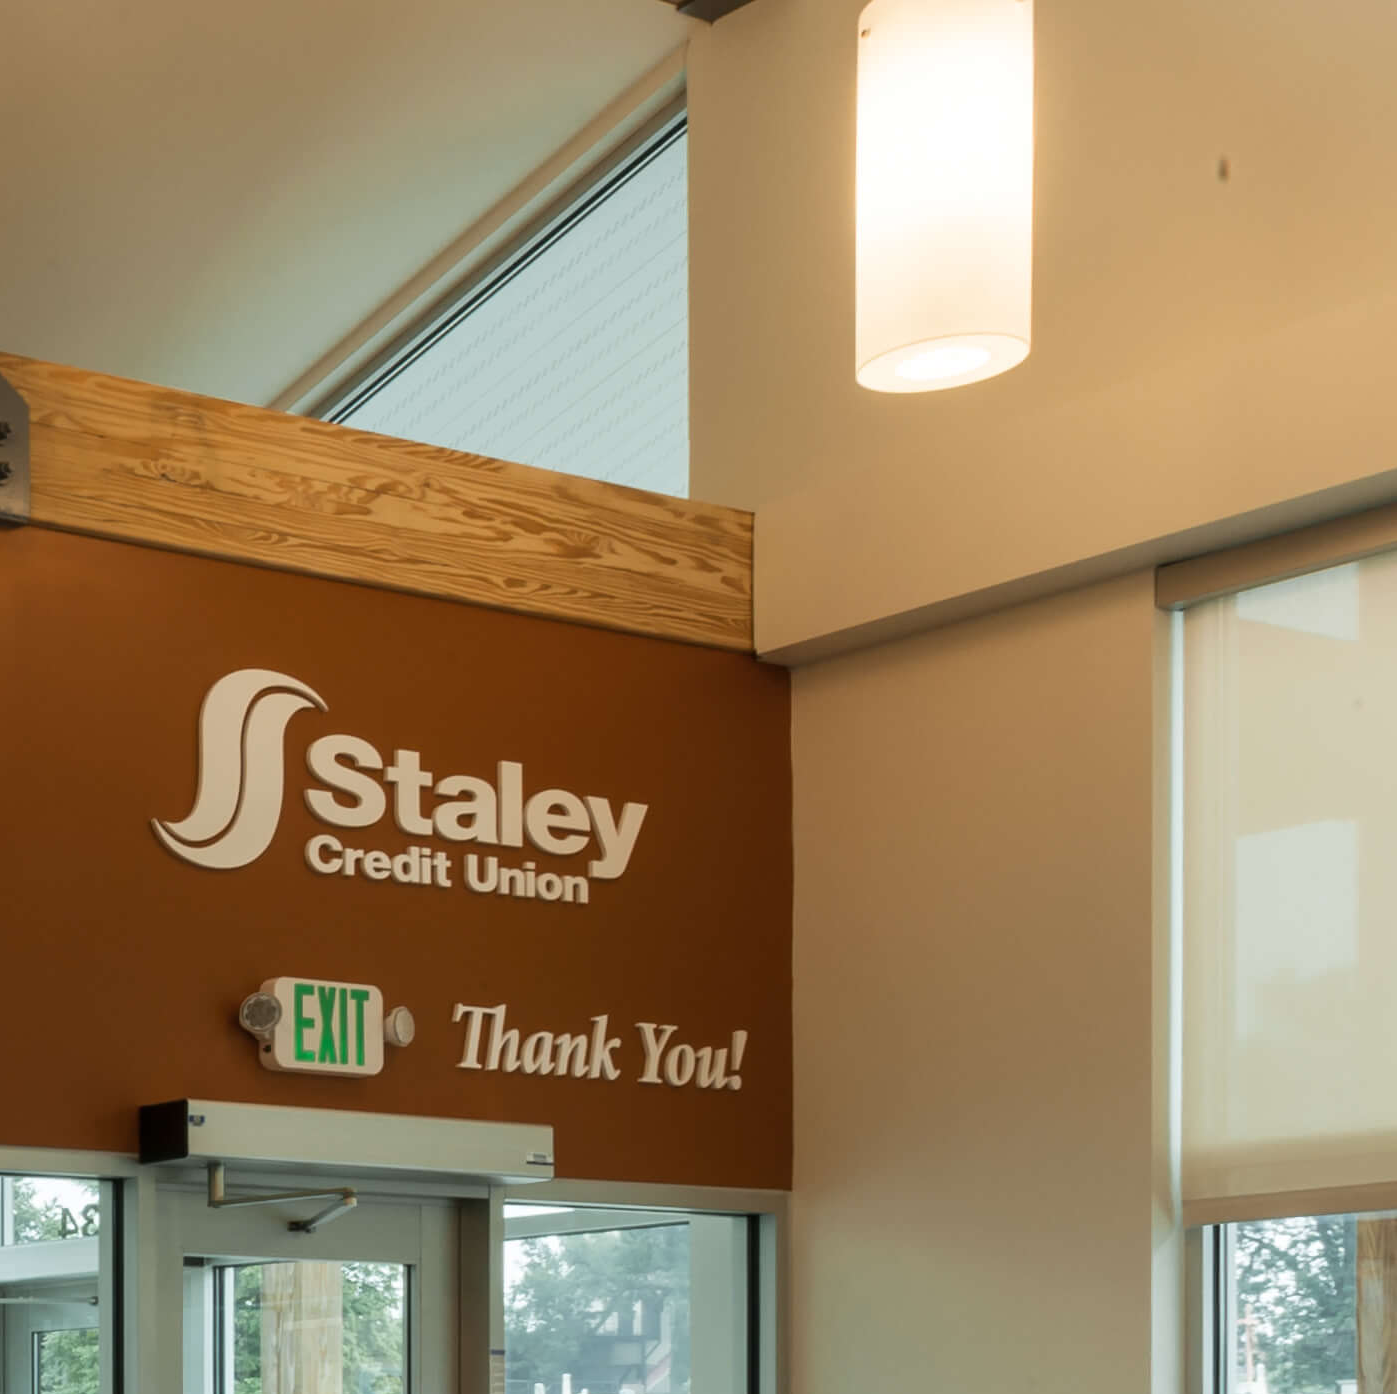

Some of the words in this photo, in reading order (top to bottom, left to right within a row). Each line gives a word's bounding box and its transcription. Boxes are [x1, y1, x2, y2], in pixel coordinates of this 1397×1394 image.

[304, 733, 649, 880] Staley
[305, 834, 453, 888] Credit
[463, 854, 589, 904] Union
[293, 983, 371, 1066] EXIT
[452, 1002, 622, 1082] Thank
[635, 1022, 749, 1091] You!
